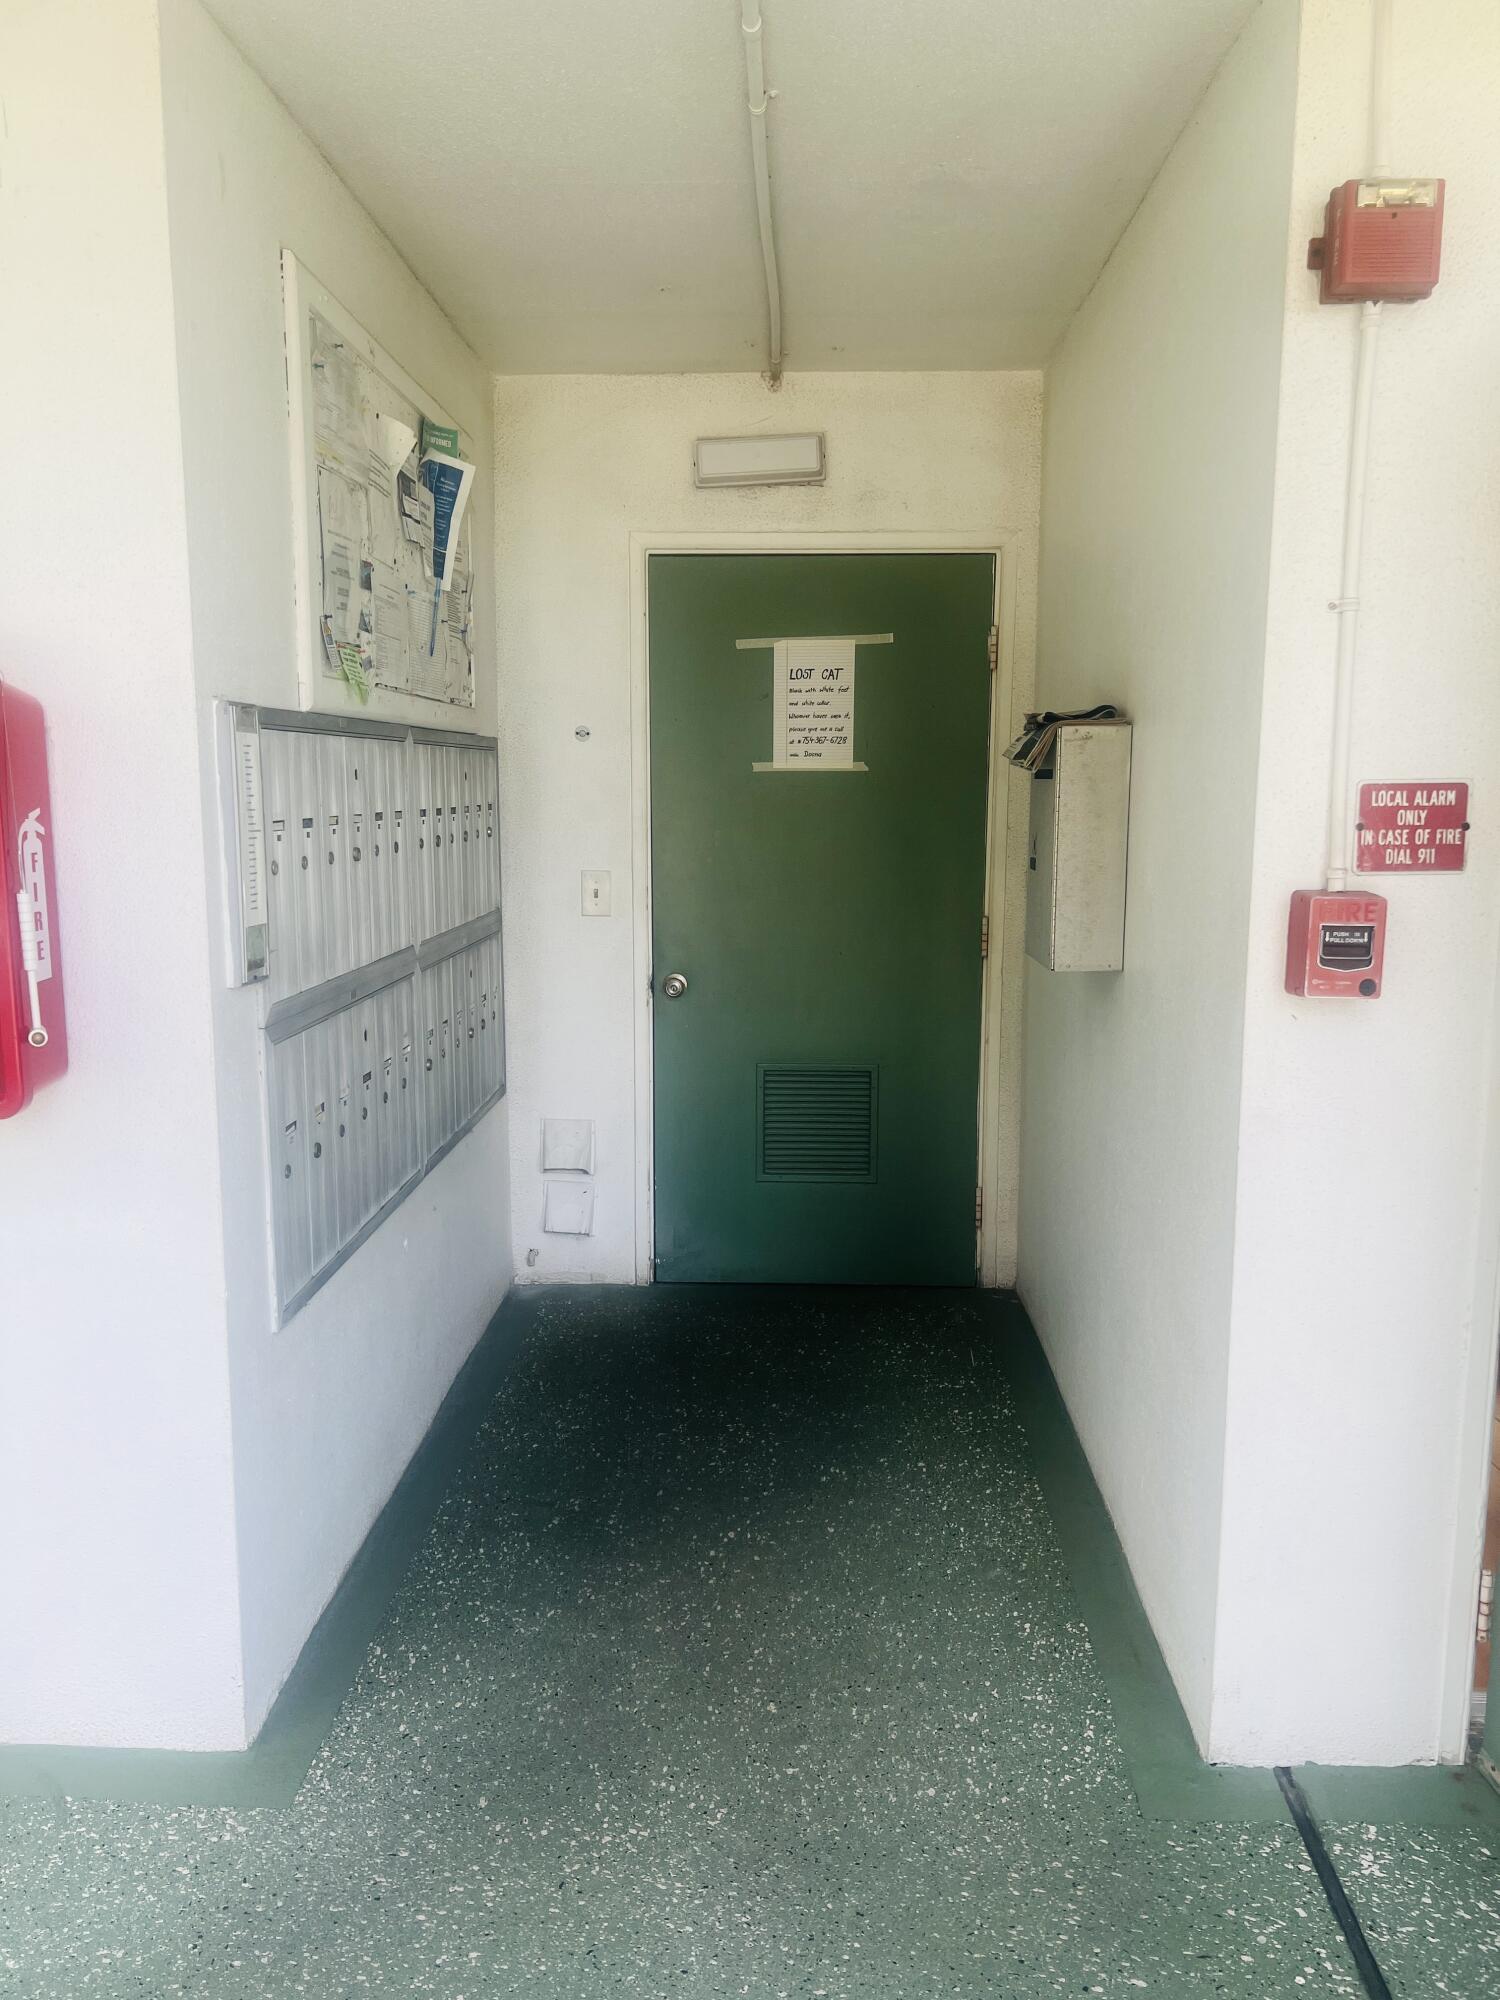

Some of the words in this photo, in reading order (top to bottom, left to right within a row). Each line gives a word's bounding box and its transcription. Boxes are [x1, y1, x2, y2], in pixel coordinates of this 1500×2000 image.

[789, 668, 815, 680] LOST
[821, 668, 844, 680] CAT
[1371, 790, 1409, 807] LOCAL
[1413, 789, 1456, 806] ALARM
[1397, 809, 1428, 826] ONLY
[1360, 830, 1375, 846] IN
[1378, 829, 1409, 846] CASE
[1415, 828, 1431, 845] OF
[1435, 828, 1462, 845] FIRE
[1385, 848, 1412, 865] DIAL
[1418, 848, 1435, 864] 911
[30, 851, 45, 961] FIRE
[1318, 902, 1378, 923] FIRE
